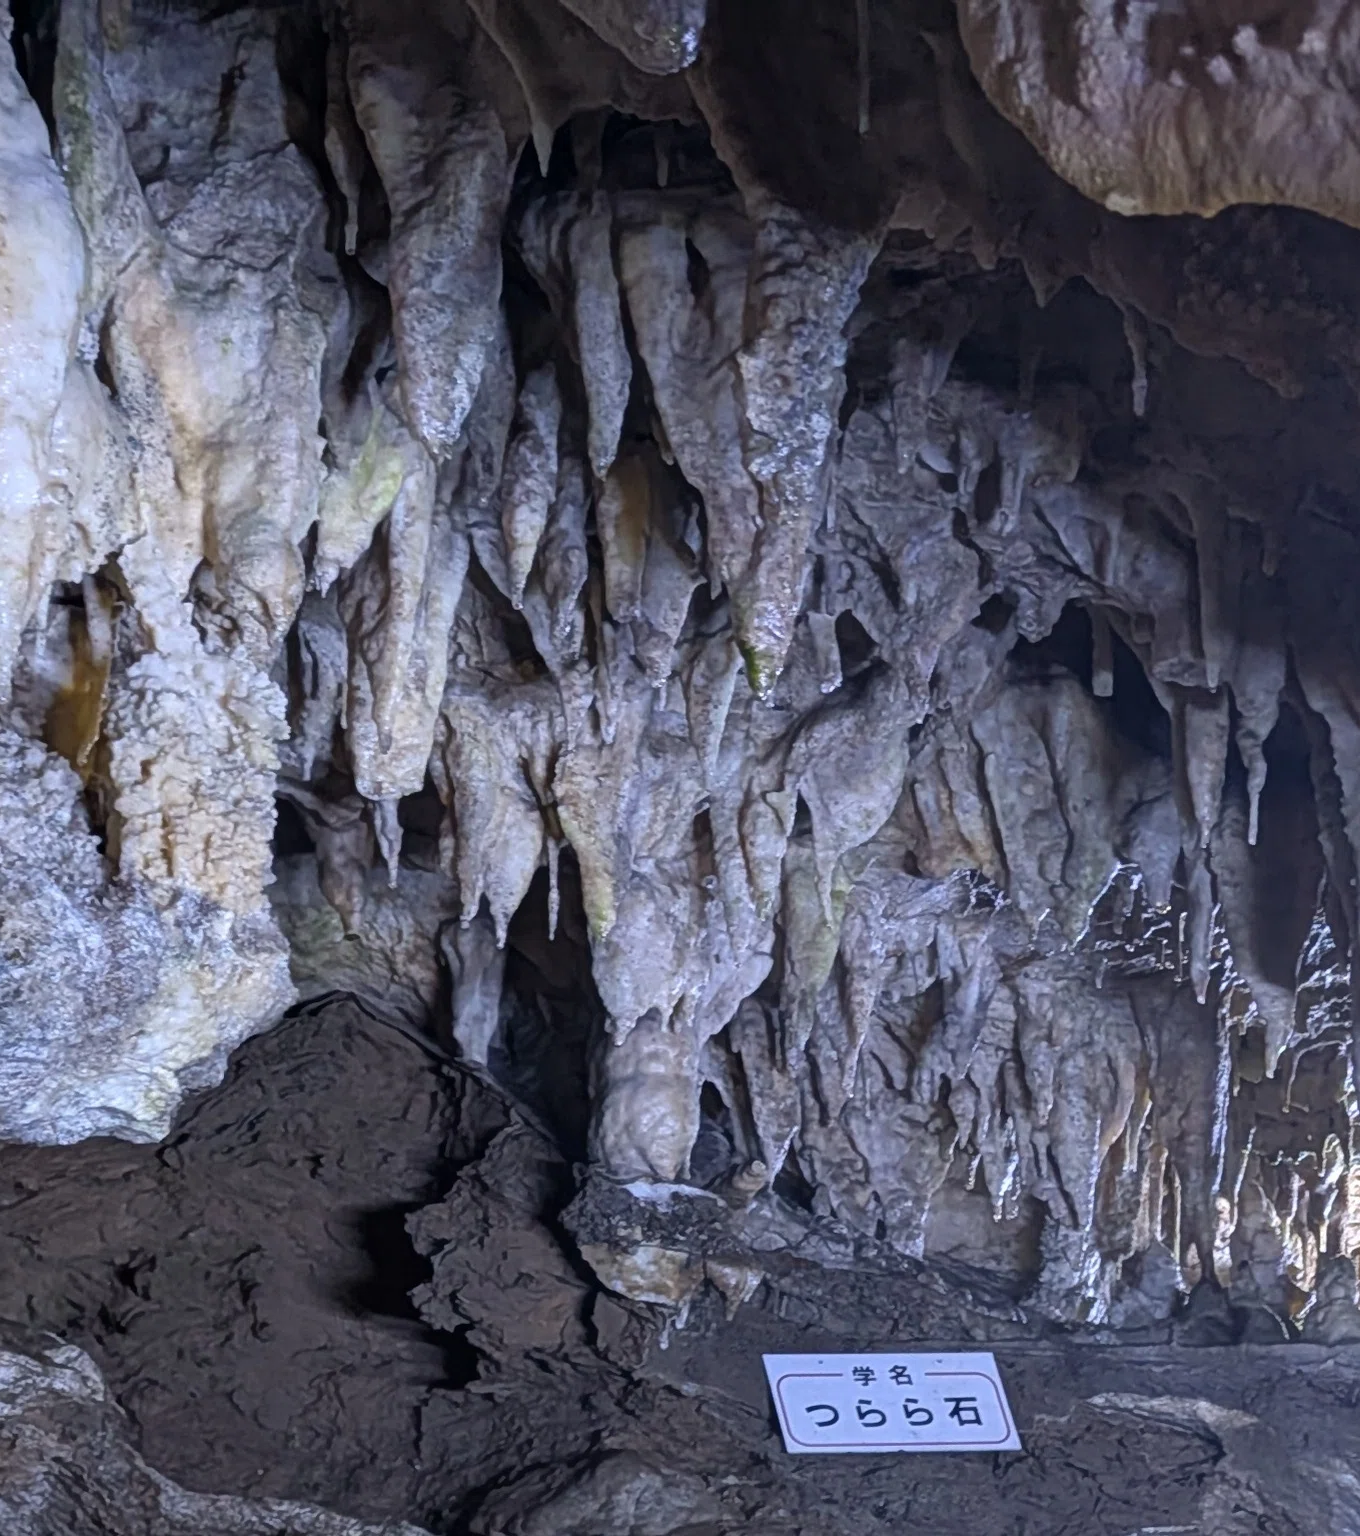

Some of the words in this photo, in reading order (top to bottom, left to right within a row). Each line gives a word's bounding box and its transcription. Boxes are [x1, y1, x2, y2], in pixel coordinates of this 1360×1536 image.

[852, 1365, 914, 1386] 学名
[805, 1396, 983, 1428] つらら石
